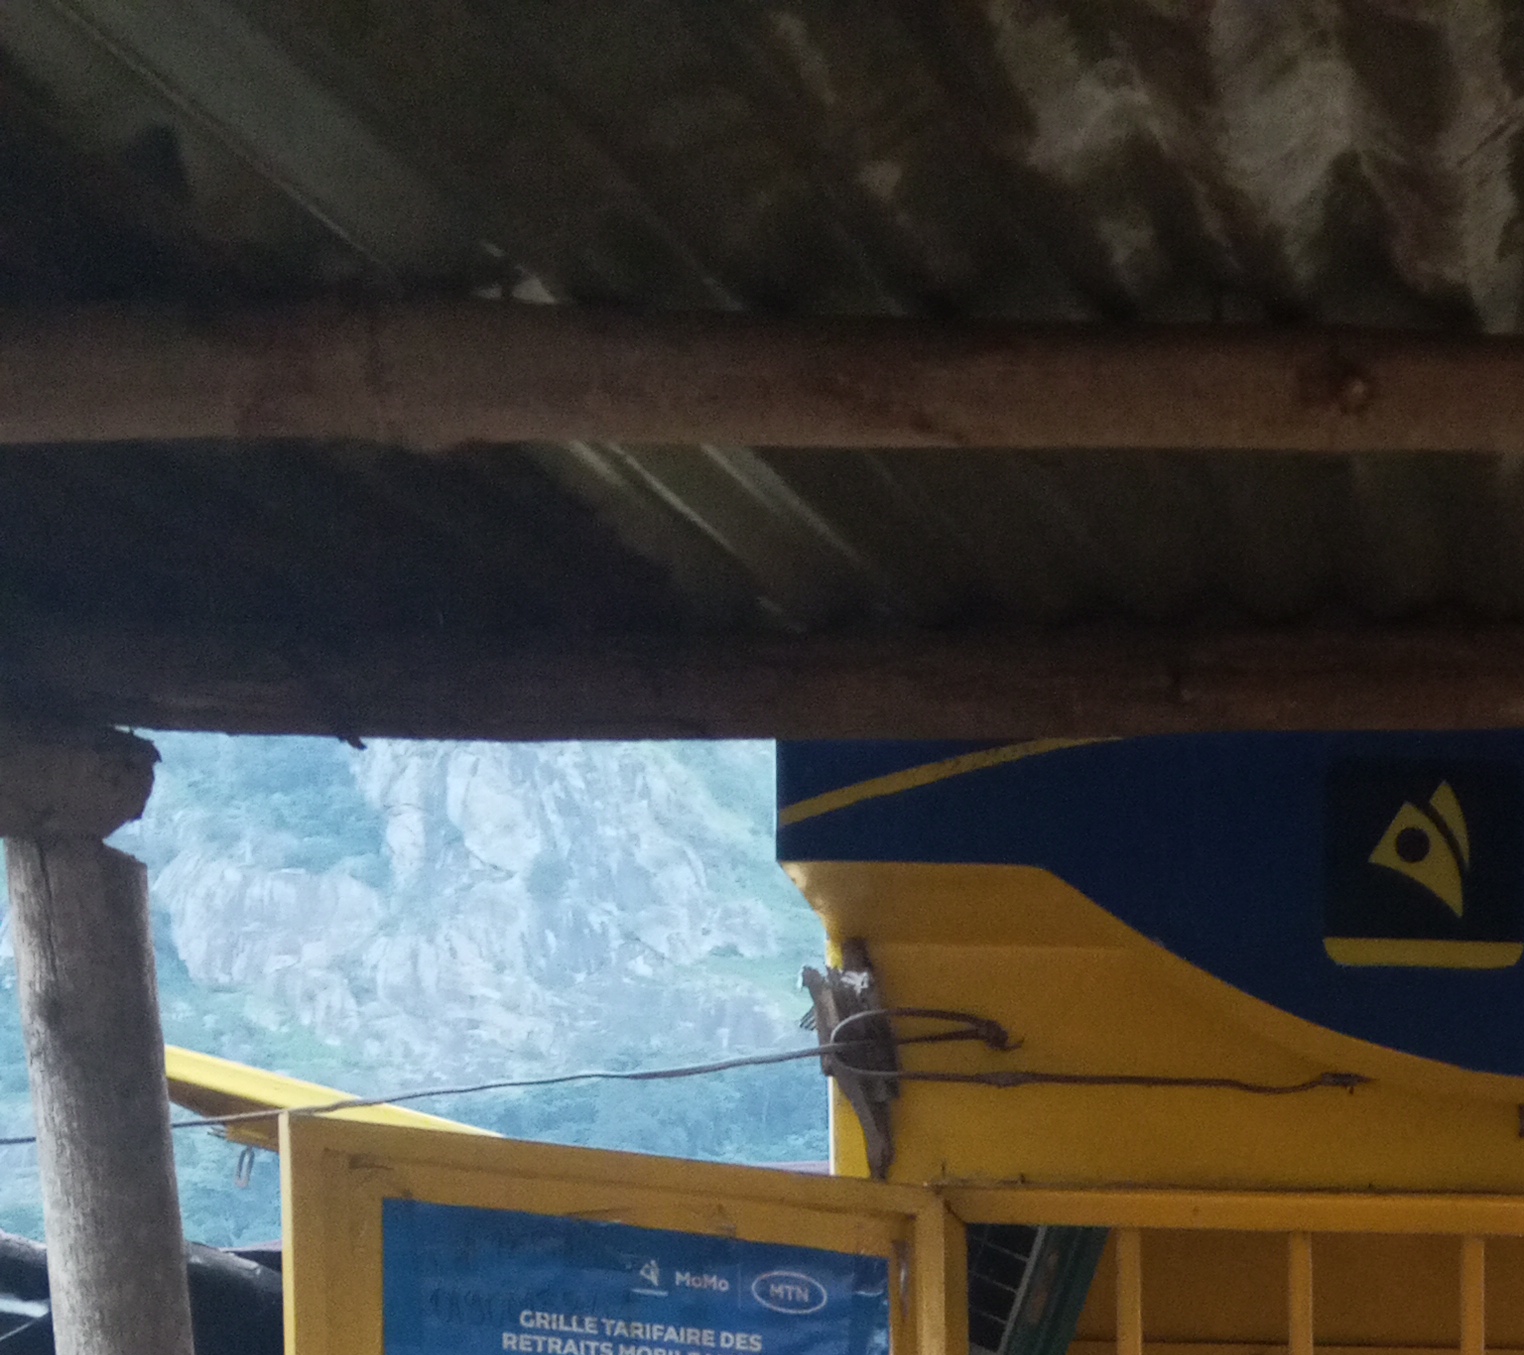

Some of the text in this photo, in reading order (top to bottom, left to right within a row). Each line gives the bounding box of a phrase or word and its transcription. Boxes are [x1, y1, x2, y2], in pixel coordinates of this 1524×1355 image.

[675, 1272, 729, 1291] MoMo
[769, 1283, 809, 1302] MTN
[519, 1310, 762, 1351] GRILLE TARIFAIRE DES
